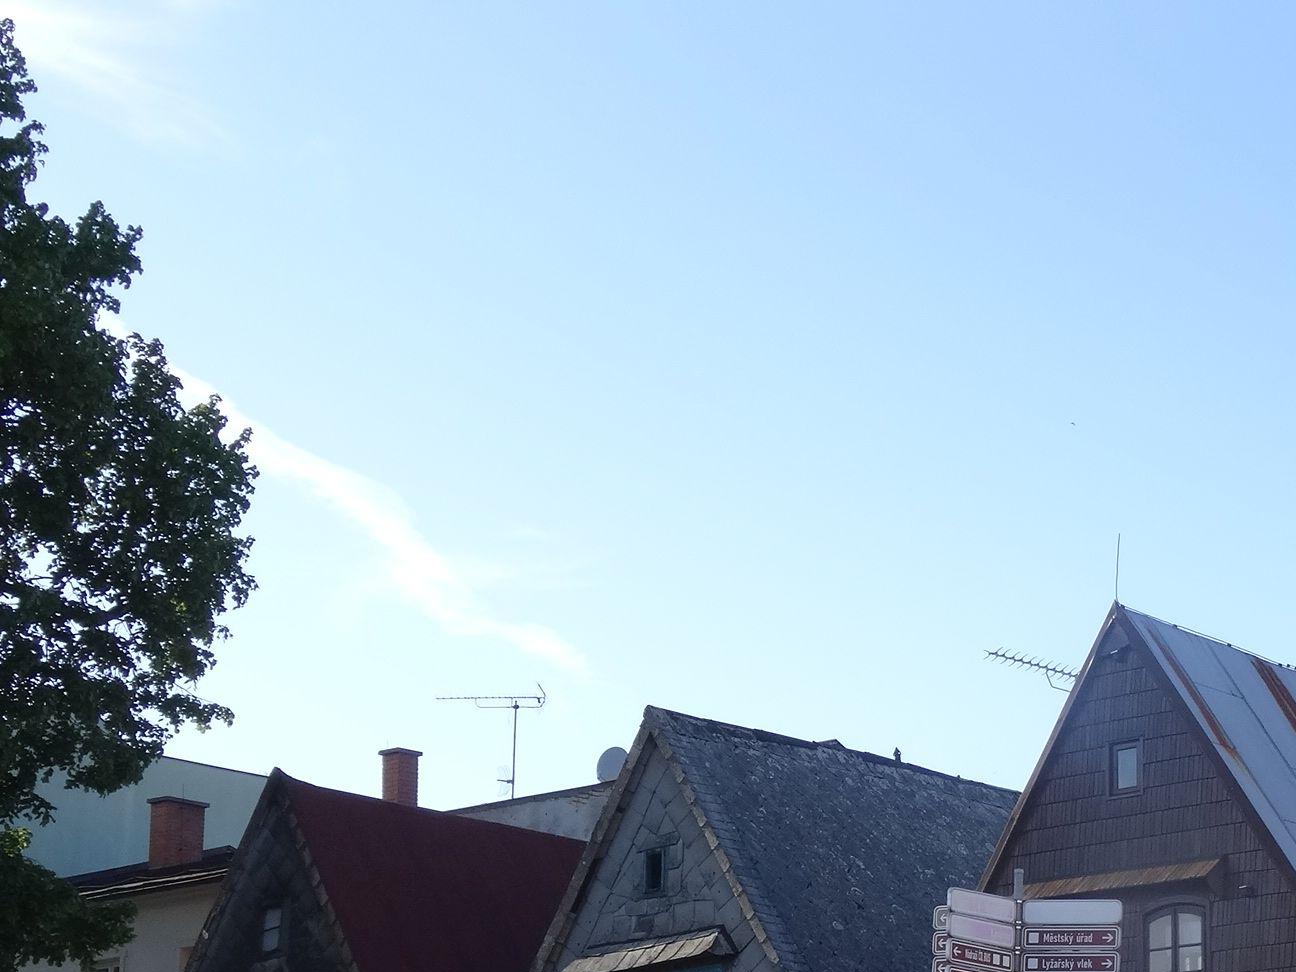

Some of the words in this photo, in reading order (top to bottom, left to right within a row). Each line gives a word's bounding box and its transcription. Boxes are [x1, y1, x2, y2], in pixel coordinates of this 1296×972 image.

[1043, 932, 1074, 945] Městský
[1076, 932, 1093, 943] úřad
[1042, 958, 1074, 971] Lyžařský
[1076, 958, 1093, 968] vlek
